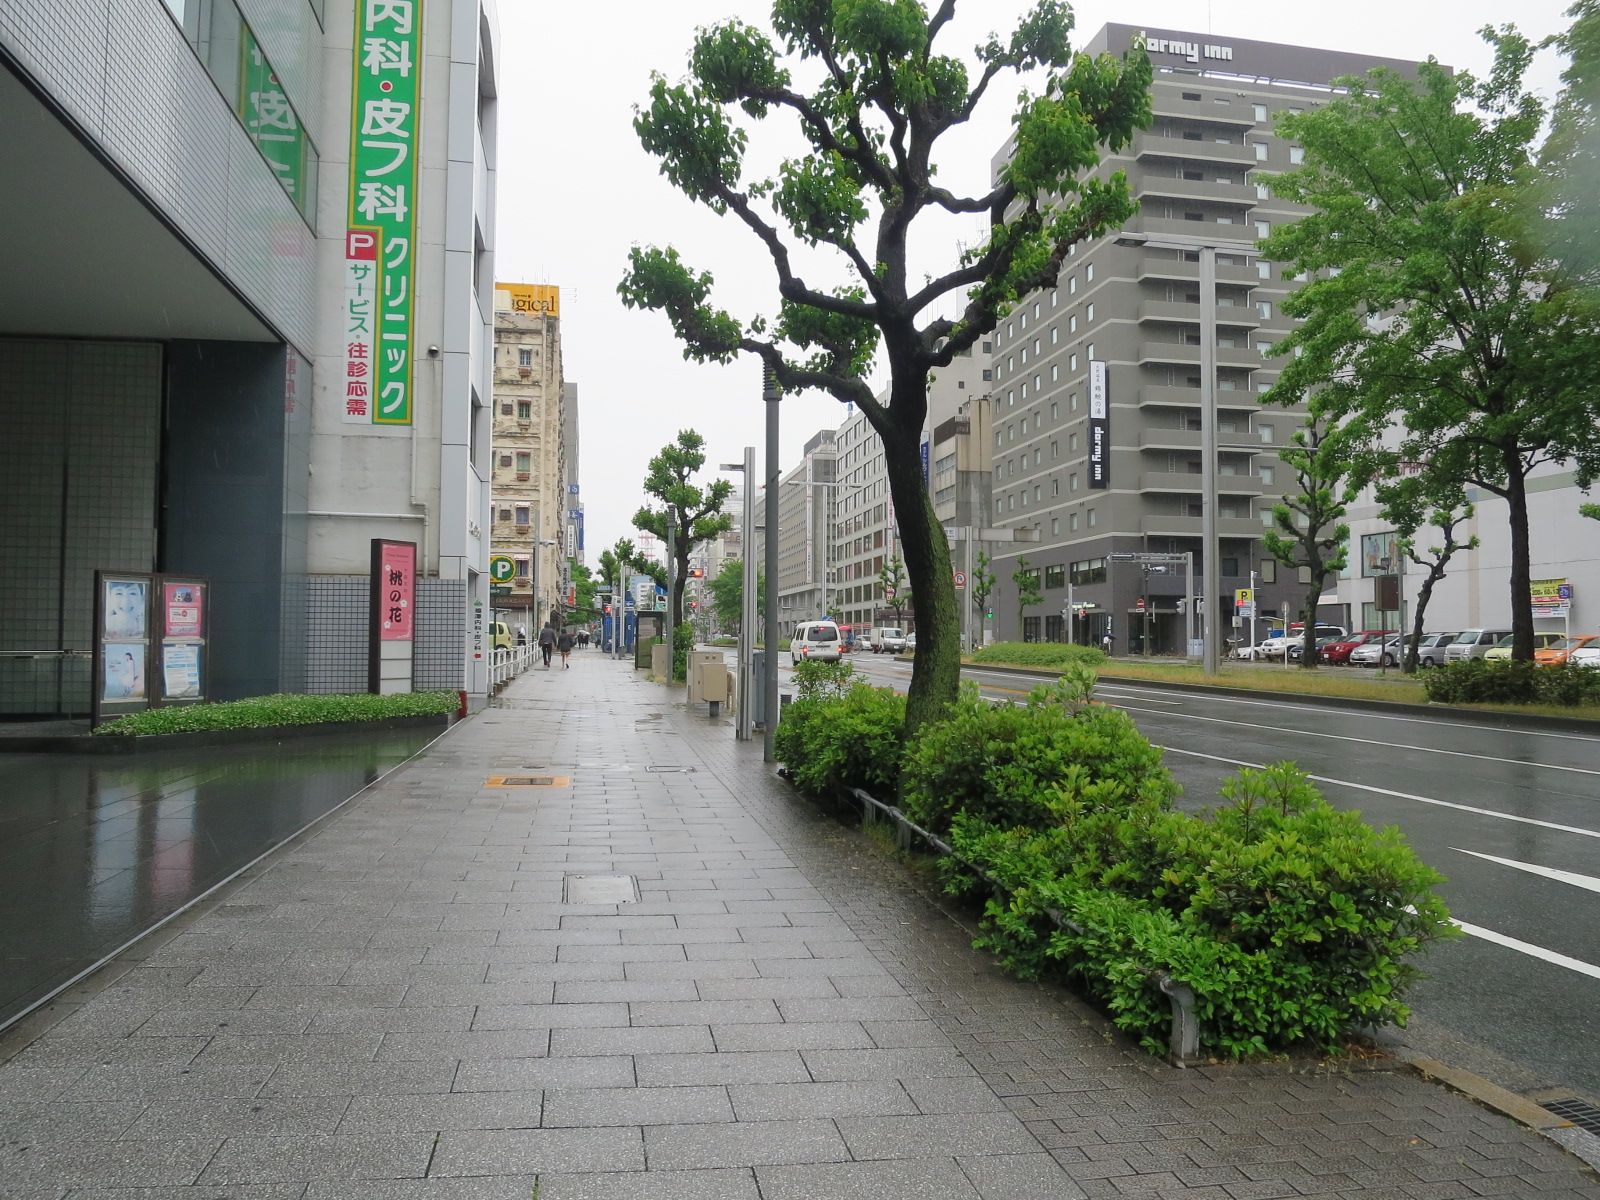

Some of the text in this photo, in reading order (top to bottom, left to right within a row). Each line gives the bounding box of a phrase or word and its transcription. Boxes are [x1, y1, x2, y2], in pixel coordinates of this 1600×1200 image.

[1204, 44, 1233, 61] inn
[350, 233, 374, 256] P
[380, 237, 408, 414] クリニック
[1091, 426, 1105, 480] dormy inn
[497, 561, 511, 578] P
[388, 568, 403, 623] 桃の花
